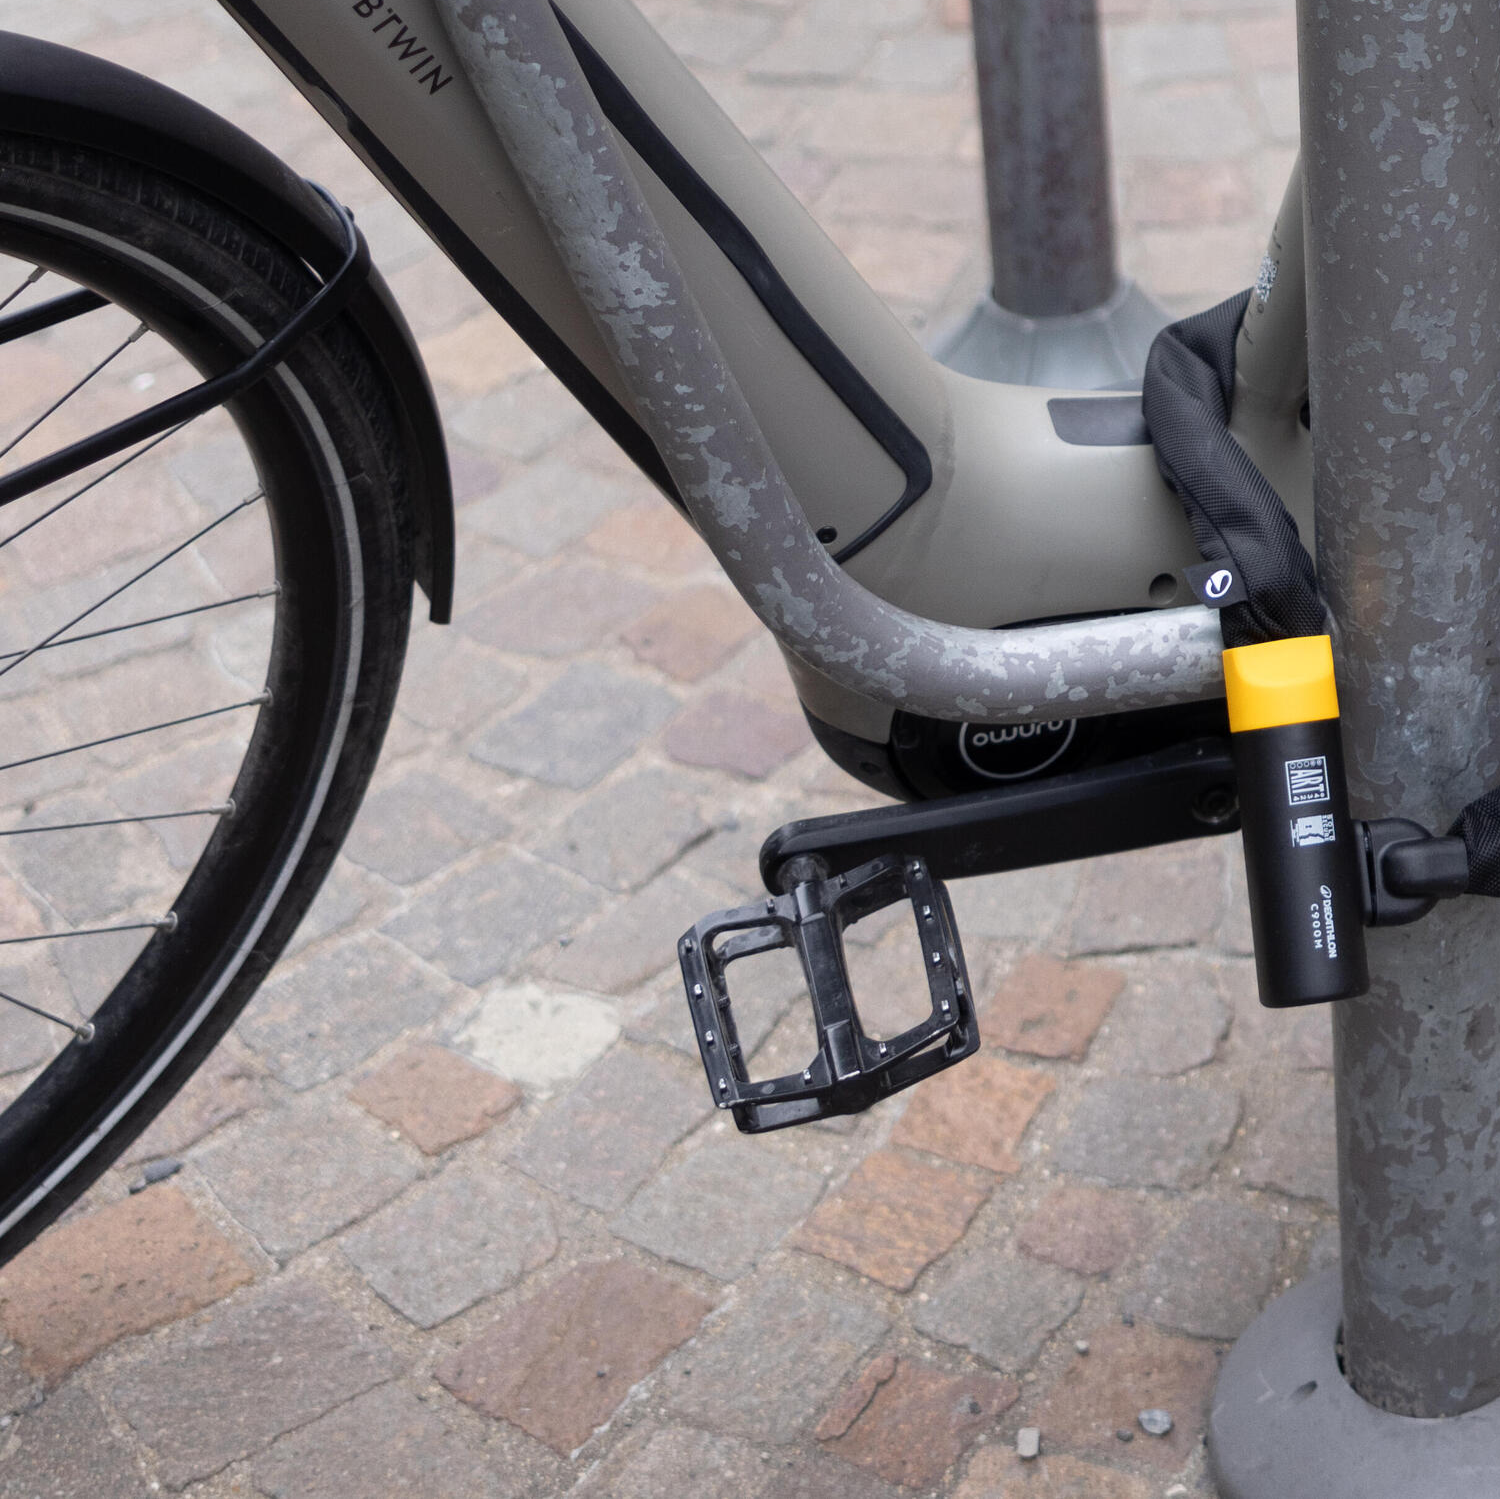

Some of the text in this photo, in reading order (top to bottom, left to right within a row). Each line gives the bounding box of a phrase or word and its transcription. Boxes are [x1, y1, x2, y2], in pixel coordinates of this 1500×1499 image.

[1289, 769, 1325, 794] ART
[1310, 903, 1323, 949] C900M
[1322, 899, 1338, 959] DECATHLON
